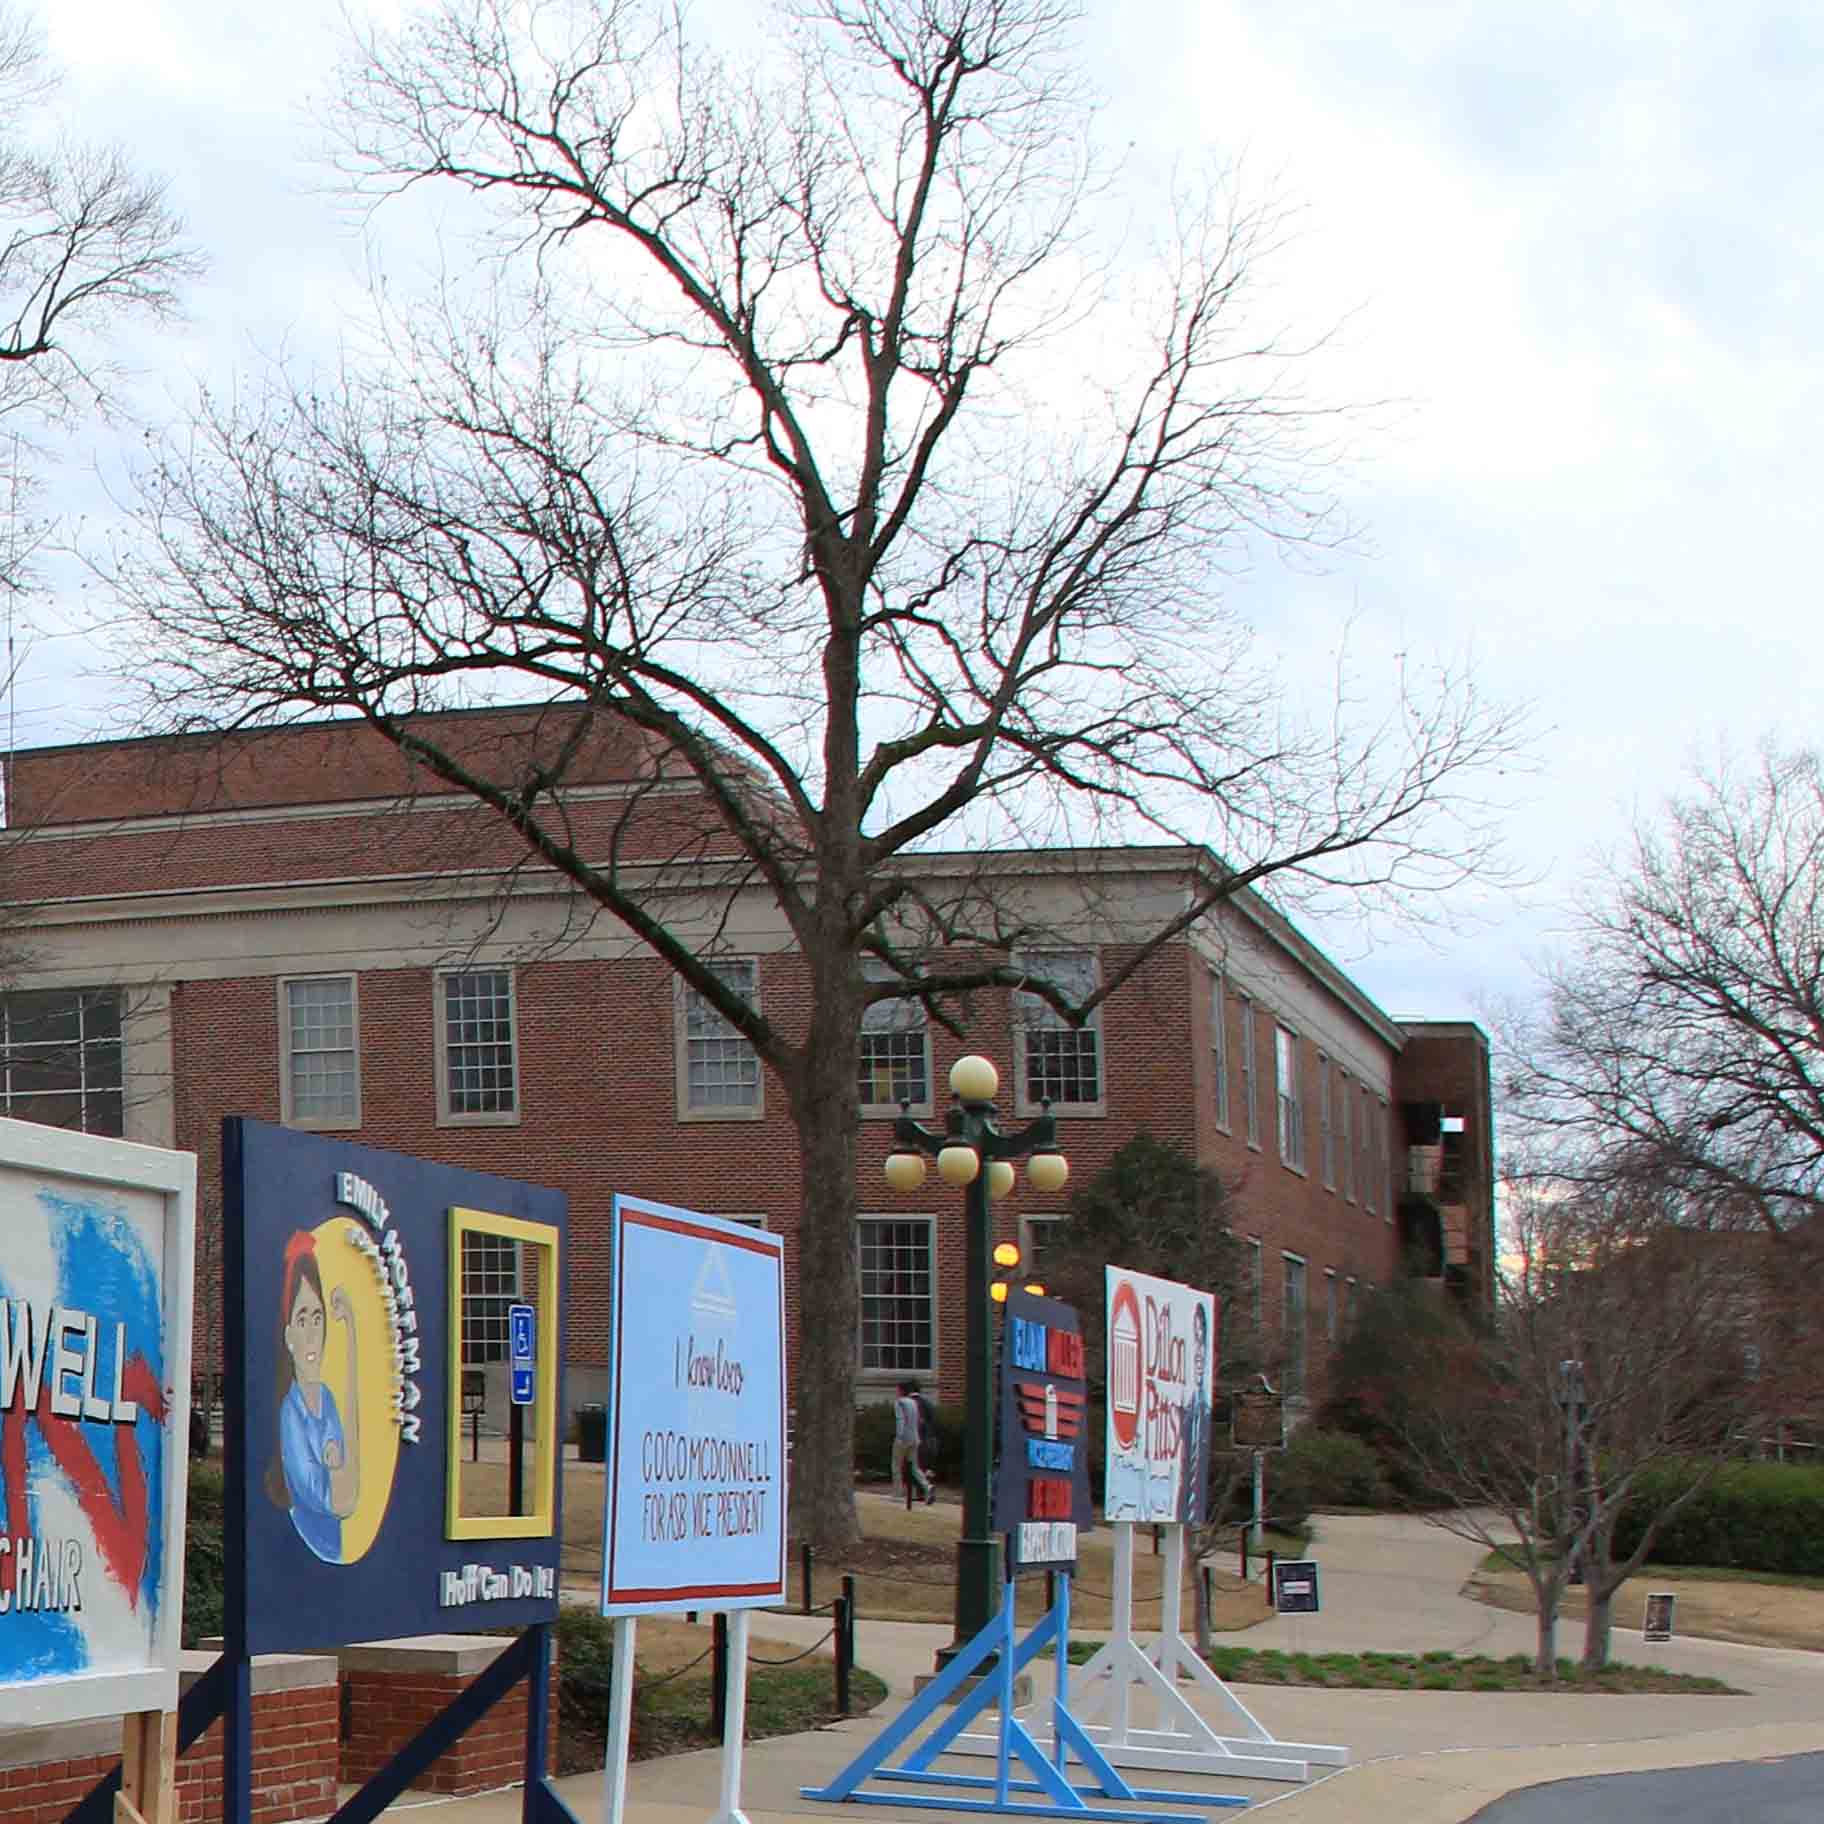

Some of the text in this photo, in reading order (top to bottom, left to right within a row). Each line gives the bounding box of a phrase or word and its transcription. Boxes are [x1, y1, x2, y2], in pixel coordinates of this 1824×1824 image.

[336, 1170, 390, 1231] EMILY
[687, 1335, 715, 1387] know
[716, 1338, 744, 1396] Coco
[642, 1431, 688, 1483] COCO
[642, 1489, 767, 1542] FOR ASB VICE PRESIDENT
[440, 1563, 479, 1608] Hoff
[479, 1565, 508, 1601] Can
[510, 1564, 532, 1599] Do
